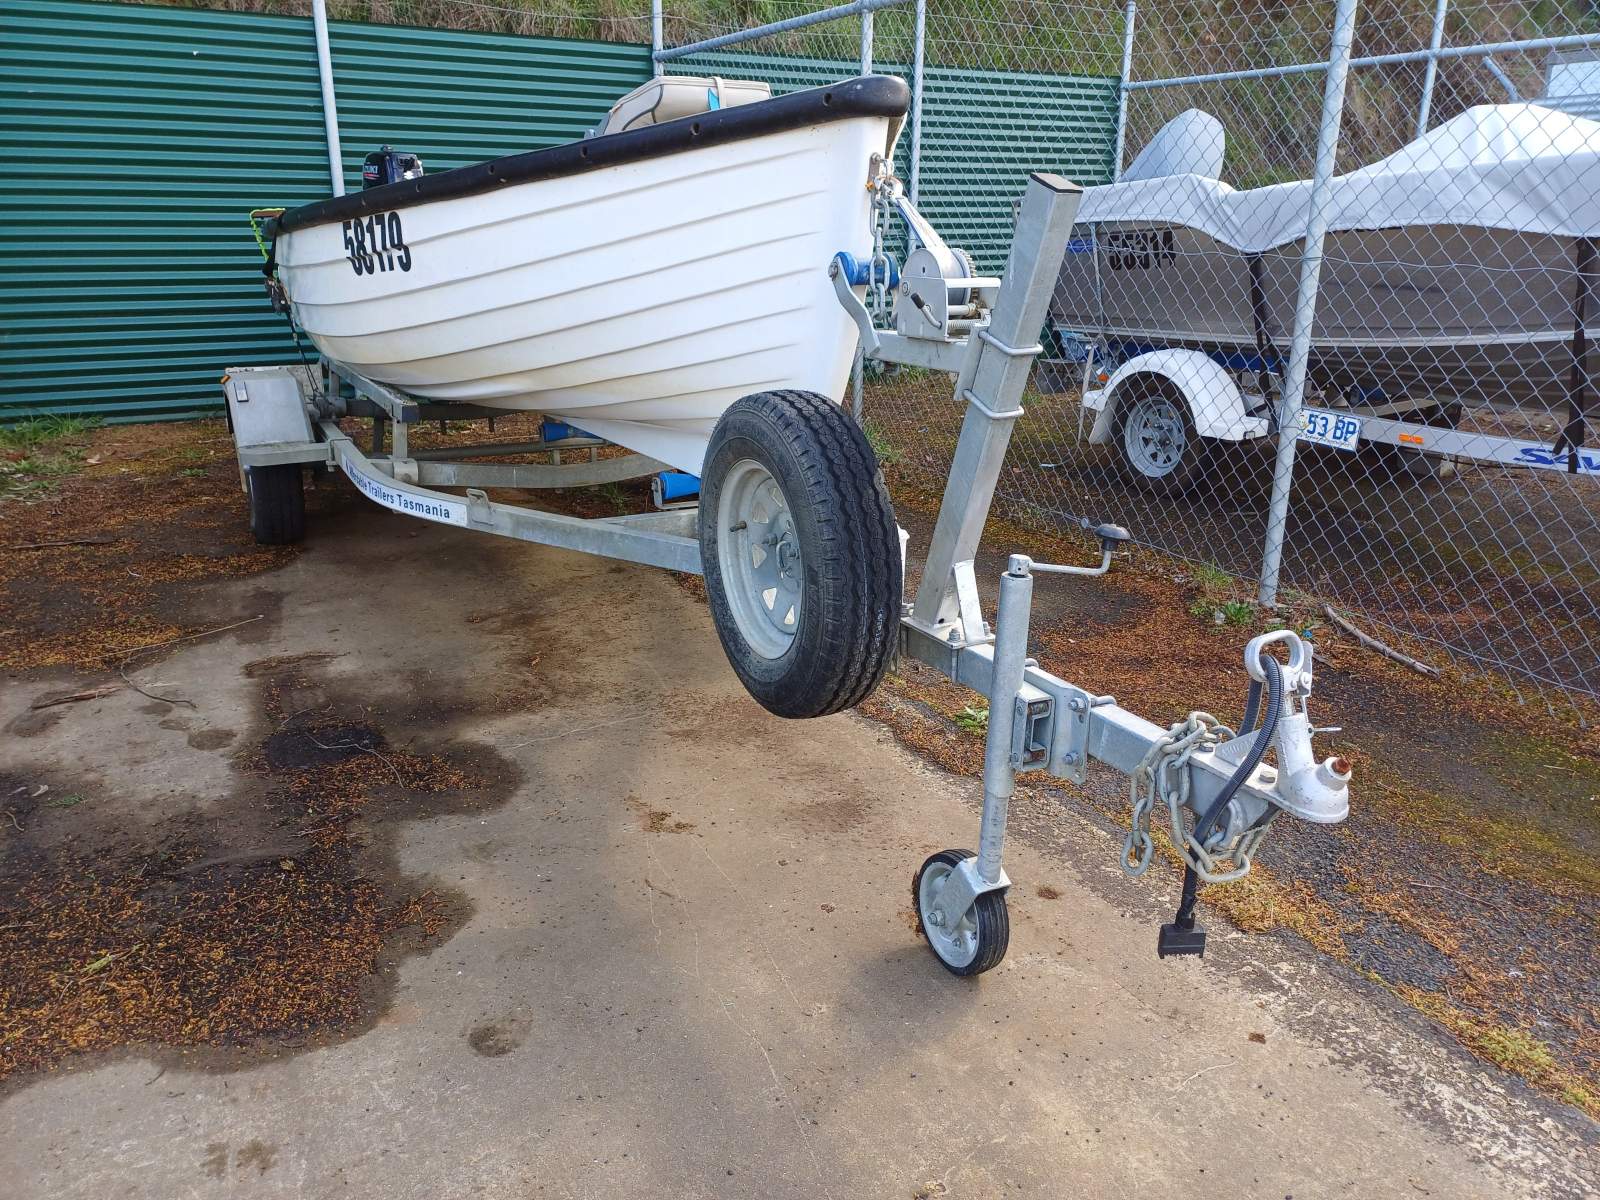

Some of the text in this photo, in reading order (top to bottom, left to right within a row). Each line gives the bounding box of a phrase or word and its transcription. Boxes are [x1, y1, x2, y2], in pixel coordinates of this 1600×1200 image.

[343, 211, 411, 276] 58179
[1307, 414, 1329, 437] 53
[1333, 419, 1356, 441] BP
[368, 482, 394, 504] Trailers
[396, 494, 450, 518] Tasmania
